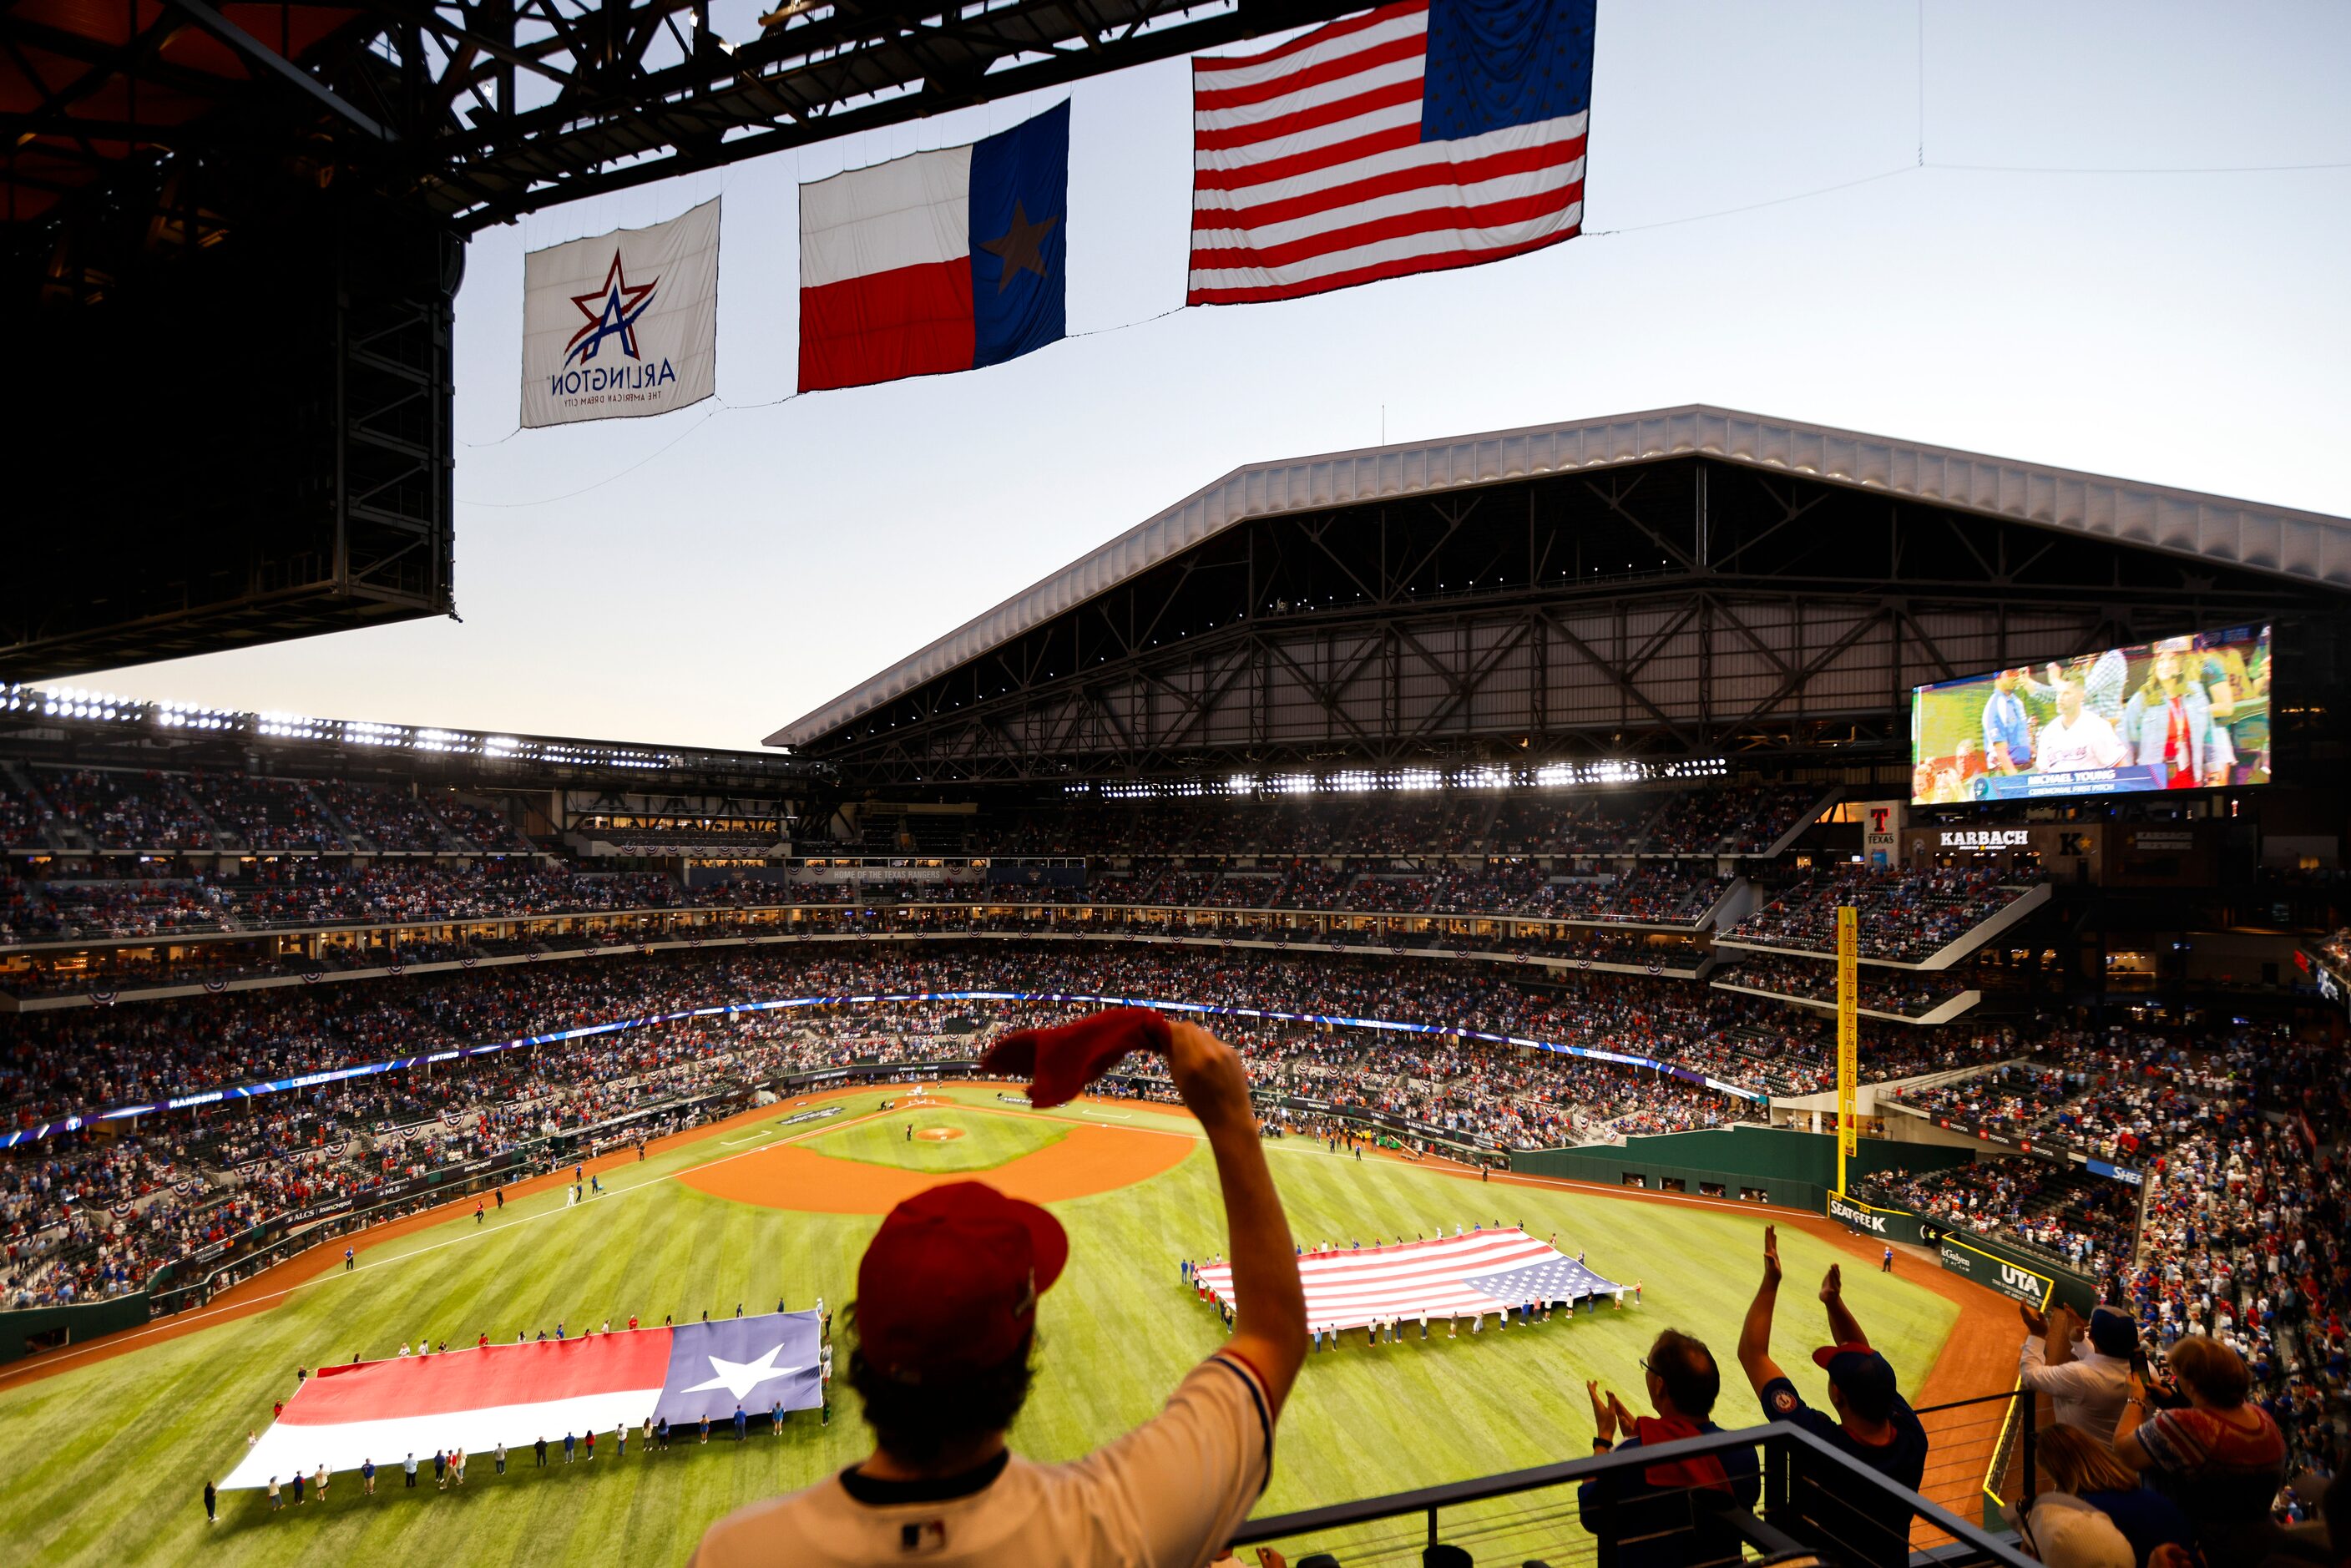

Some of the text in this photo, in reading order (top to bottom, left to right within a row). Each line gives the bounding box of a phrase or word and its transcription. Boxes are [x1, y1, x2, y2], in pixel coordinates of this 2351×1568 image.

[2028, 770, 2116, 785] MICHAEL YOUNG
[2029, 787, 2070, 796] CEREMONIAL
[1871, 808, 1890, 832] T
[1868, 835, 1894, 844] TEXAS
[1940, 831, 2029, 846] KARBACH
[2060, 833, 2083, 856] K
[427, 1051, 459, 1062] ASTROS
[169, 1091, 223, 1109] RANGERS
[1950, 1123, 1969, 1132] TOYOTA
[1989, 1134, 2010, 1145] TOYOTA
[2032, 1146, 2054, 1157] TOYOTA
[385, 1186, 401, 1196] MLB
[294, 1199, 352, 1222] ALCS loanDepot
[1858, 1205, 1871, 1214] 334
[1992, 1278, 2001, 1287] THE
[2001, 1264, 2041, 1297] UTA
